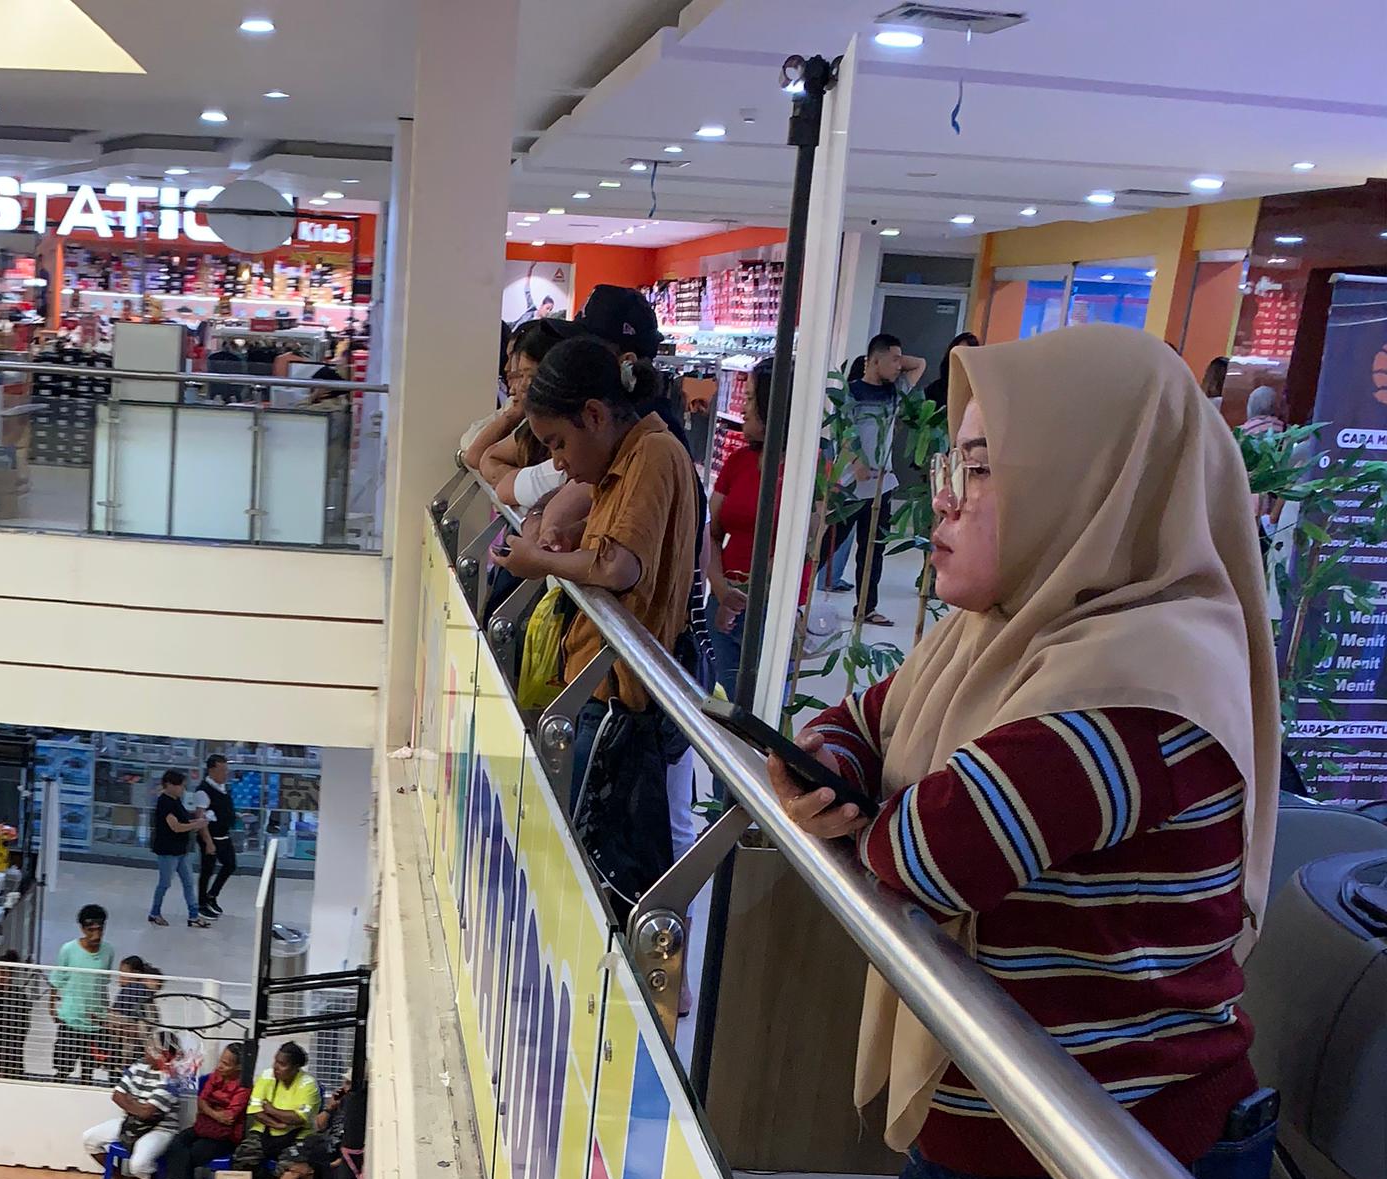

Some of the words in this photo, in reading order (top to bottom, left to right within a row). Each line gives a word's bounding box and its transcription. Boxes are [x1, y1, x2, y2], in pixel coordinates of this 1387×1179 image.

[298, 221, 352, 244] Kids
[1341, 633, 1386, 648] Menit
[1336, 656, 1381, 670] Menit
